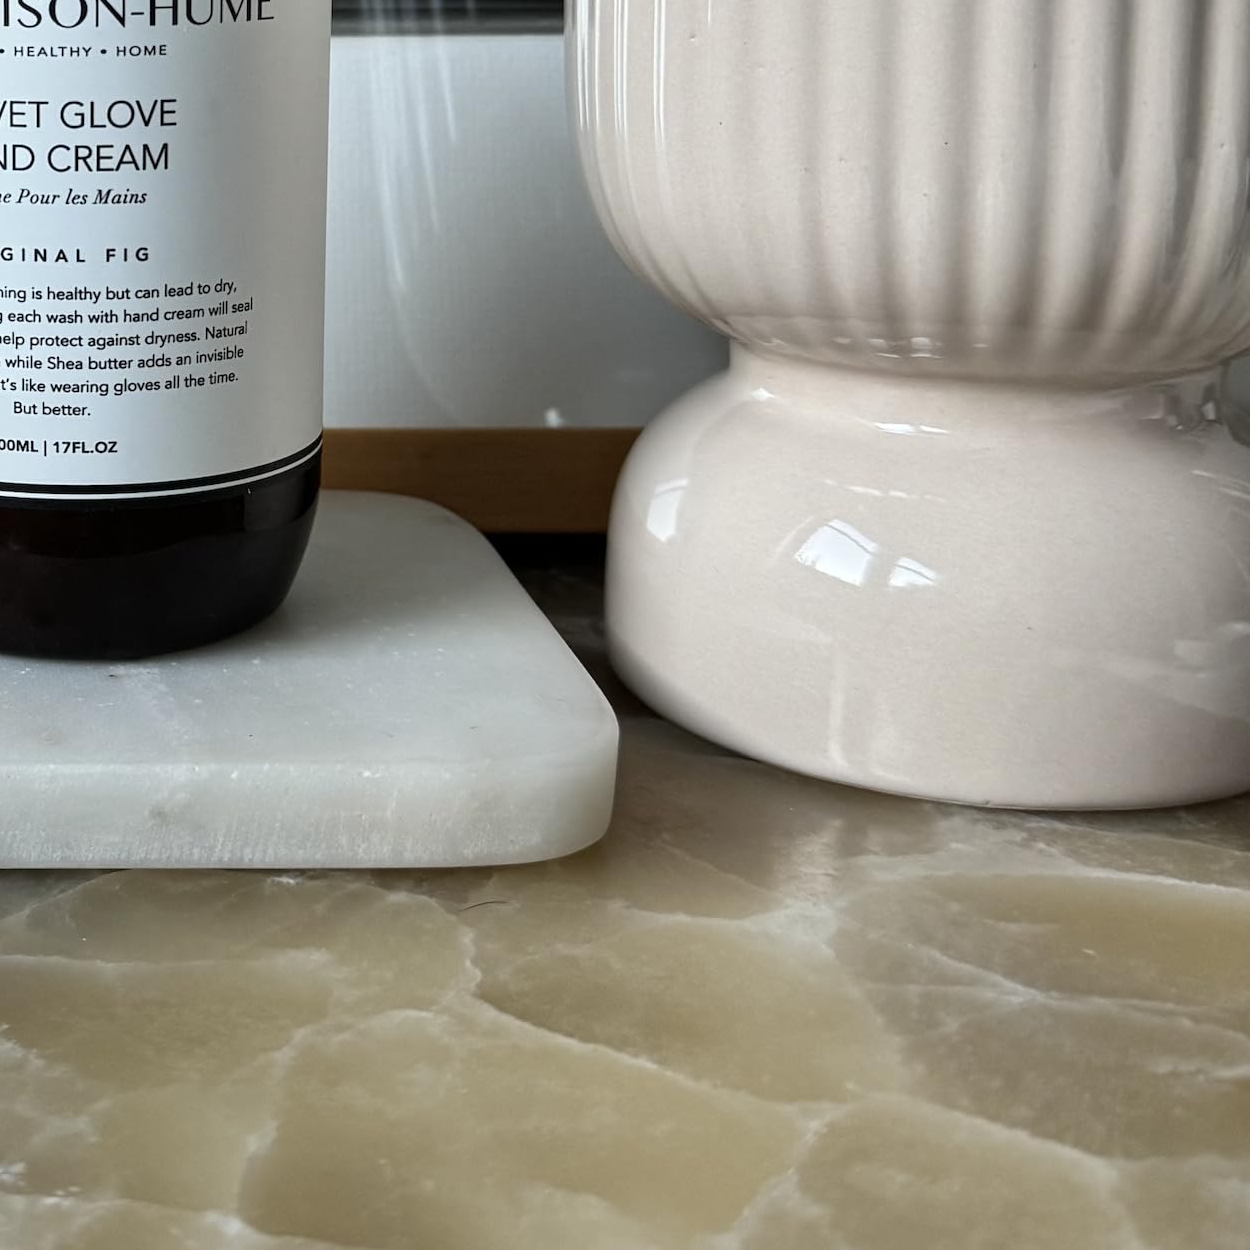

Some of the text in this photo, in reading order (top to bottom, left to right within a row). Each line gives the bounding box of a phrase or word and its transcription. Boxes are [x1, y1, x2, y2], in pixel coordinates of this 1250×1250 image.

[13, 45, 93, 58] HEALTHY
[115, 44, 167, 58] HOME
[59, 98, 178, 130] GLOVE
[46, 142, 169, 174] CREAM
[14, 187, 61, 205] Pour
[64, 187, 89, 206] les
[91, 187, 148, 205] Mains
[105, 246, 149, 263] FIG
[31, 286, 43, 301] is
[46, 285, 102, 305] healthy
[105, 285, 132, 301] but
[134, 288, 160, 300] can
[164, 281, 194, 298] lead
[196, 282, 211, 295] to
[214, 277, 237, 296] dry,
[7, 308, 42, 324] each
[45, 309, 84, 325] wash
[87, 309, 119, 324] with
[123, 306, 160, 324] hand
[163, 307, 205, 321] cream
[207, 300, 229, 317] will
[231, 296, 254, 314] seal
[29, 334, 85, 351] protect
[87, 333, 141, 351] against
[144, 330, 201, 349] dryness.
[205, 320, 248, 341] Natural
[4, 354, 43, 370] while
[46, 355, 84, 371] Shea
[87, 355, 134, 371] butter
[136, 352, 173, 369] adds
[175, 355, 192, 366] an
[195, 344, 245, 365] invisible
[21, 377, 47, 393] like
[49, 379, 110, 397] wearing
[113, 377, 161, 397] gloves
[164, 374, 180, 390] all
[183, 373, 206, 389] the
[207, 371, 239, 385] time.
[13, 400, 92, 417] But better.
[52, 440, 119, 455] 17FL.OZ
